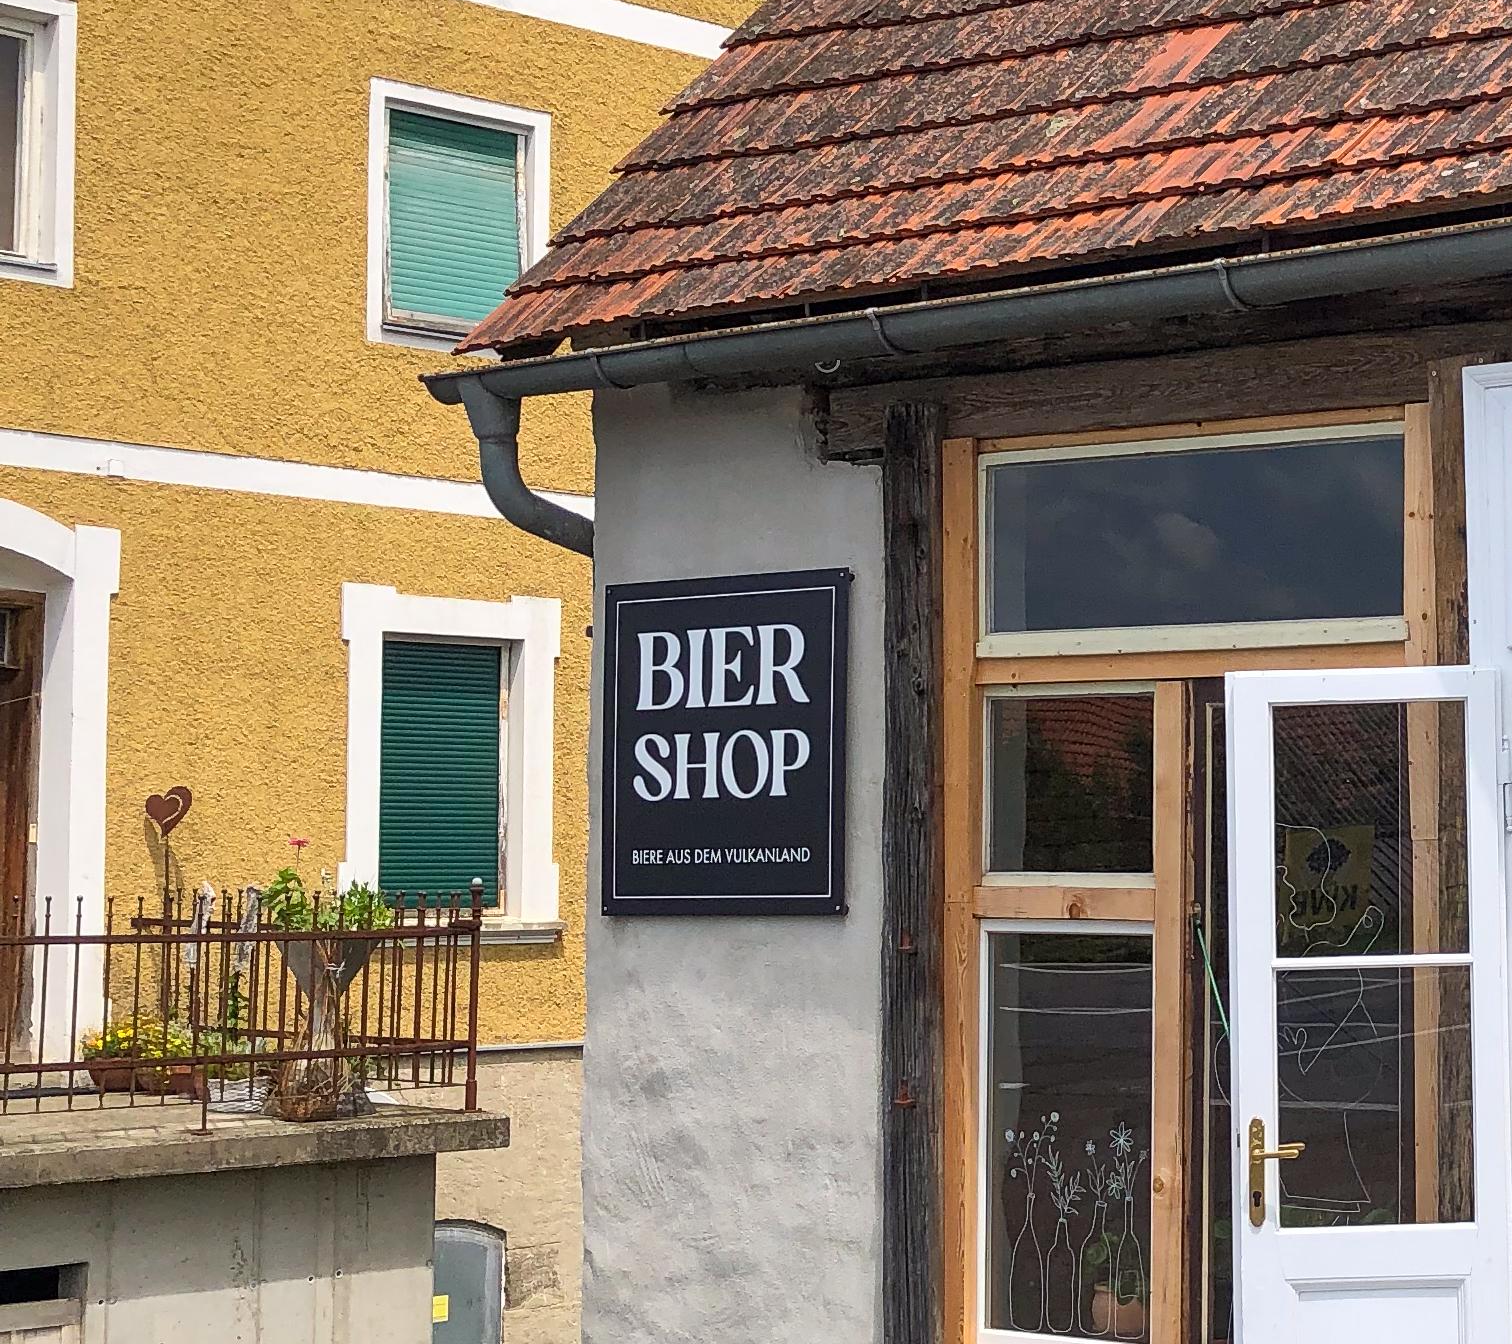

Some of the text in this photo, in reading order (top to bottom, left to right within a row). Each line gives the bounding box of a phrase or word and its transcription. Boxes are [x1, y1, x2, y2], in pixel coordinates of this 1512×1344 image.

[635, 623, 811, 711] BIER
[632, 729, 811, 802] SHOP
[632, 847, 811, 865] BIERE AUS DEM VULKANLAND
